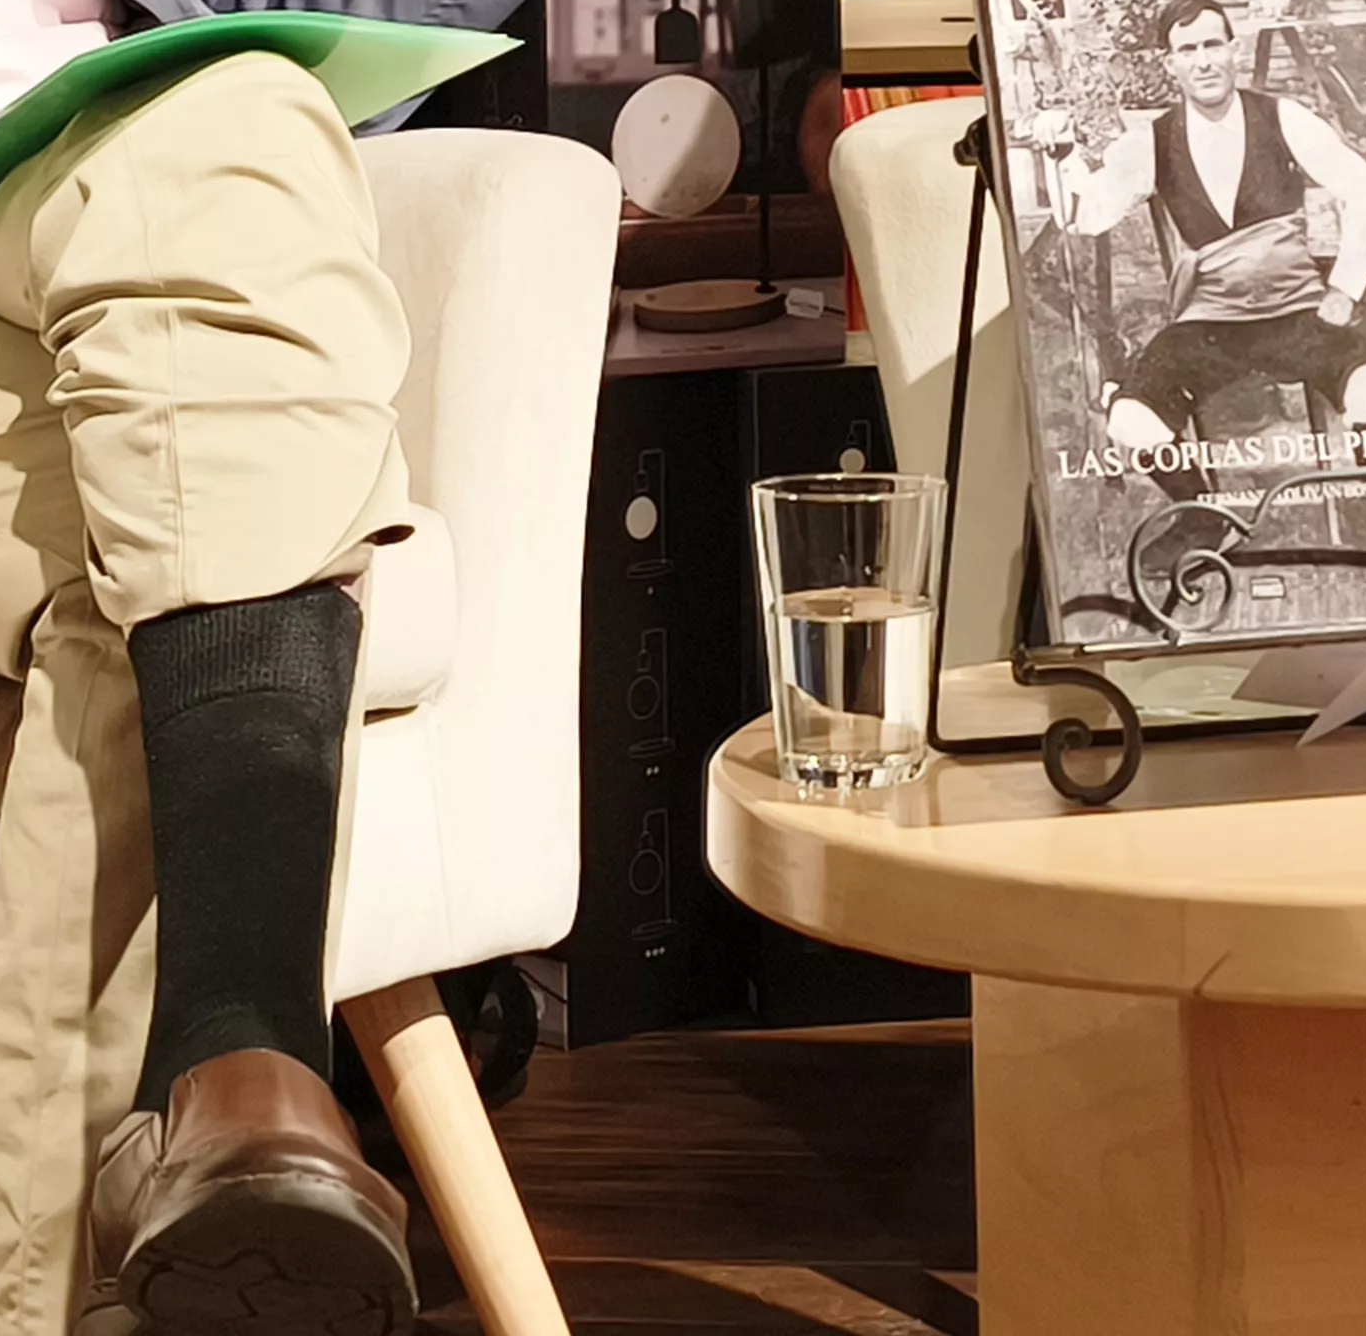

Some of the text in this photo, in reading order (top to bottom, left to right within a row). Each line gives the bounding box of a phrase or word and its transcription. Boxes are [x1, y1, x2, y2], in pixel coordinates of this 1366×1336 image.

[1057, 447, 1125, 480] LAS
[1131, 435, 1265, 474] COPLAS
[1272, 430, 1333, 465] DEL
